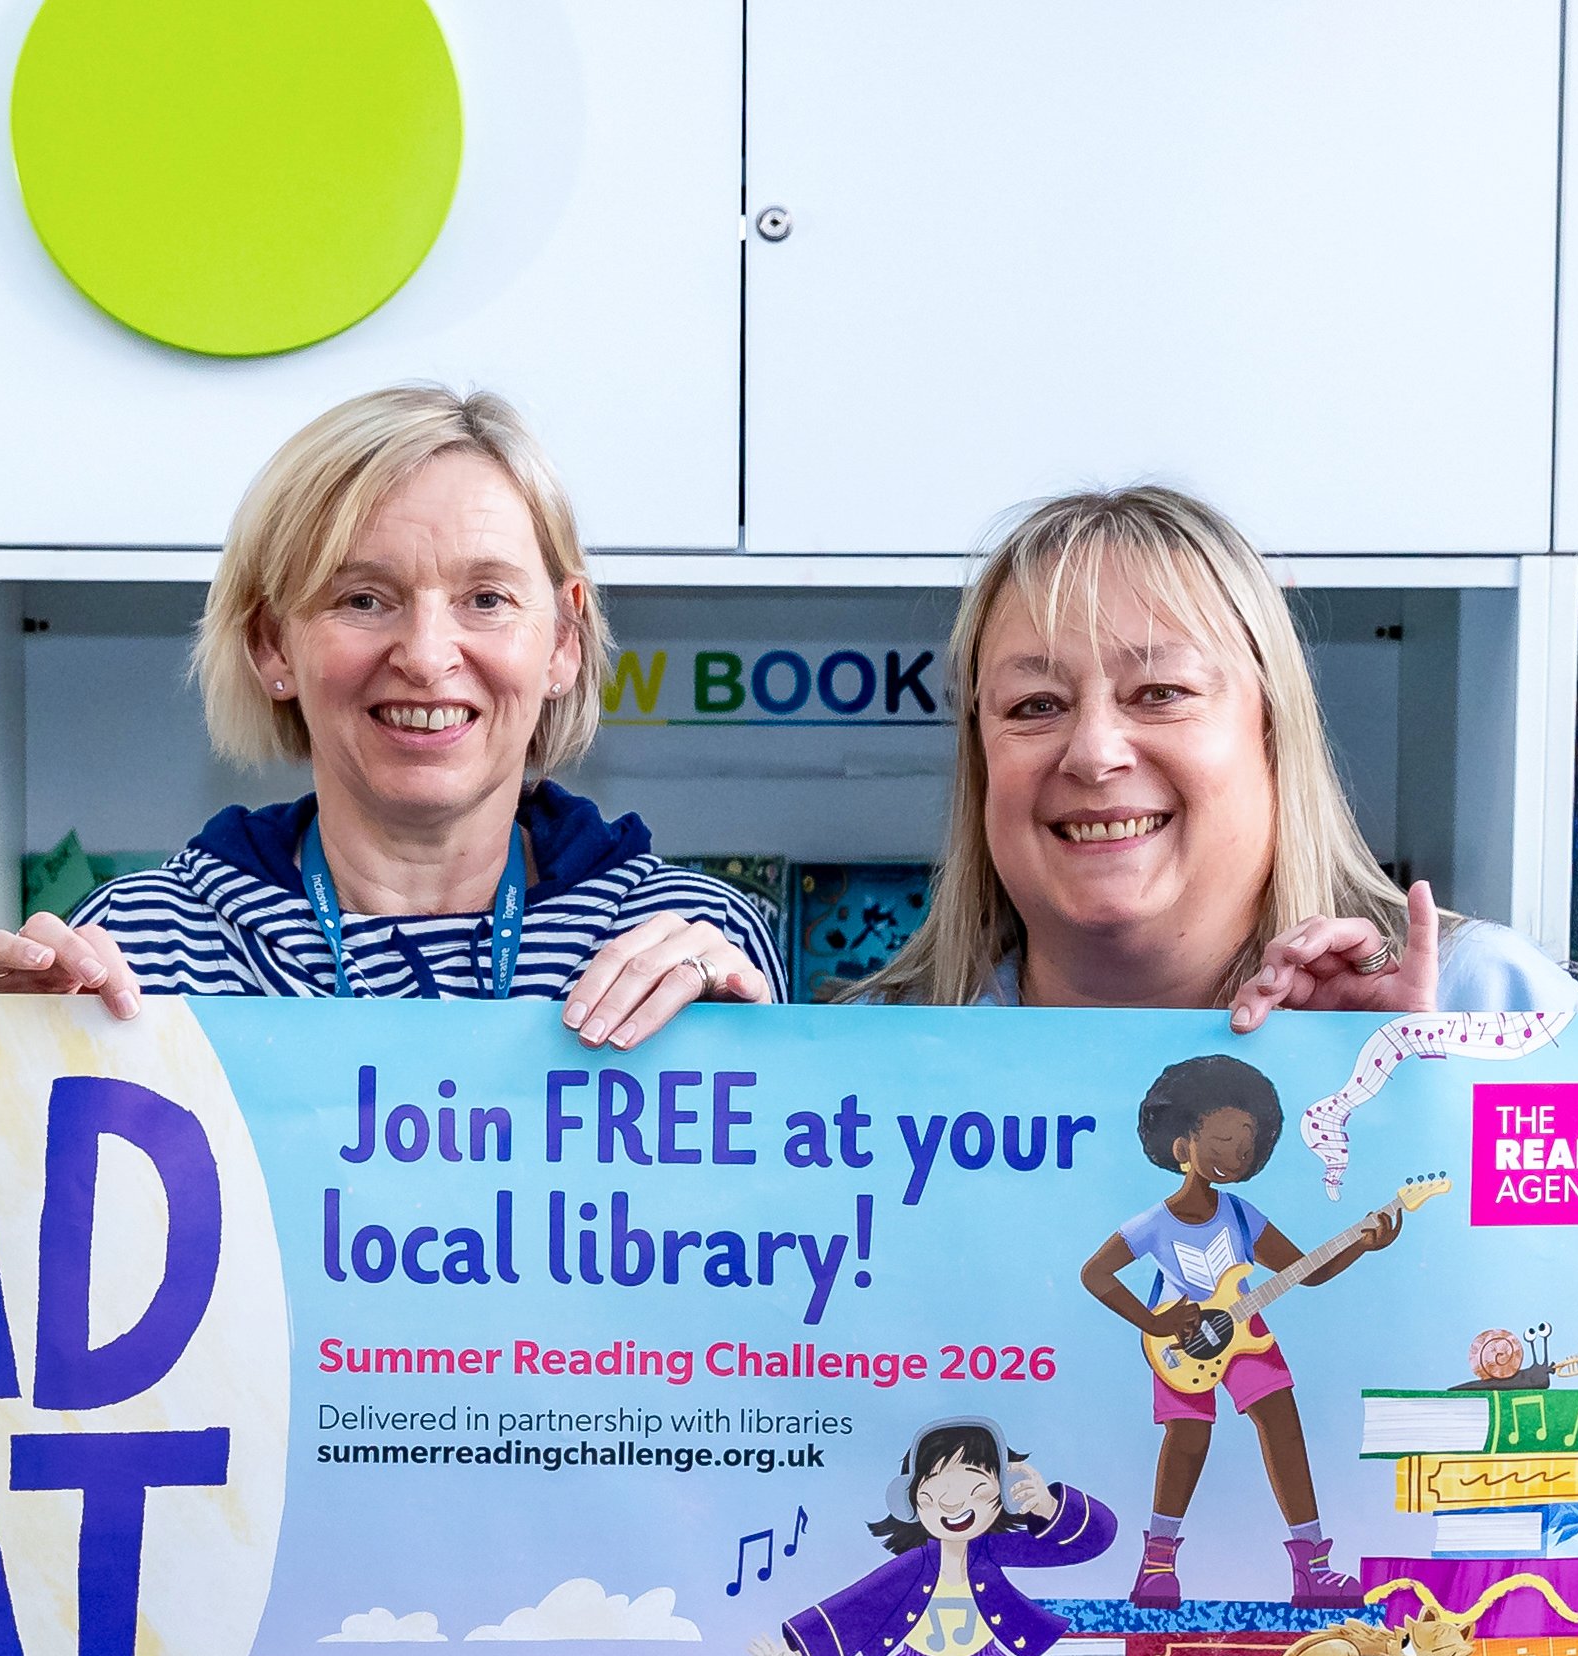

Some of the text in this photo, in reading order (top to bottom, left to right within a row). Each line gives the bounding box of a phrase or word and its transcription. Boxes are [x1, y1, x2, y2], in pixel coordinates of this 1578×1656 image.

[694, 649, 938, 714] BOOK
[311, 873, 328, 913] Inclusive
[502, 885, 517, 920] Together
[499, 947, 510, 990] Creative
[339, 1064, 1096, 1206] Join FREE at your
[1495, 1105, 1556, 1135] THE
[323, 1187, 874, 1325] local library!
[317, 1339, 1057, 1386] Summer Reading Challenge 2026
[317, 1404, 854, 1441] Delivered in partnership with libraries
[316, 1439, 827, 1472] summerreadingchallenge.org.uk
